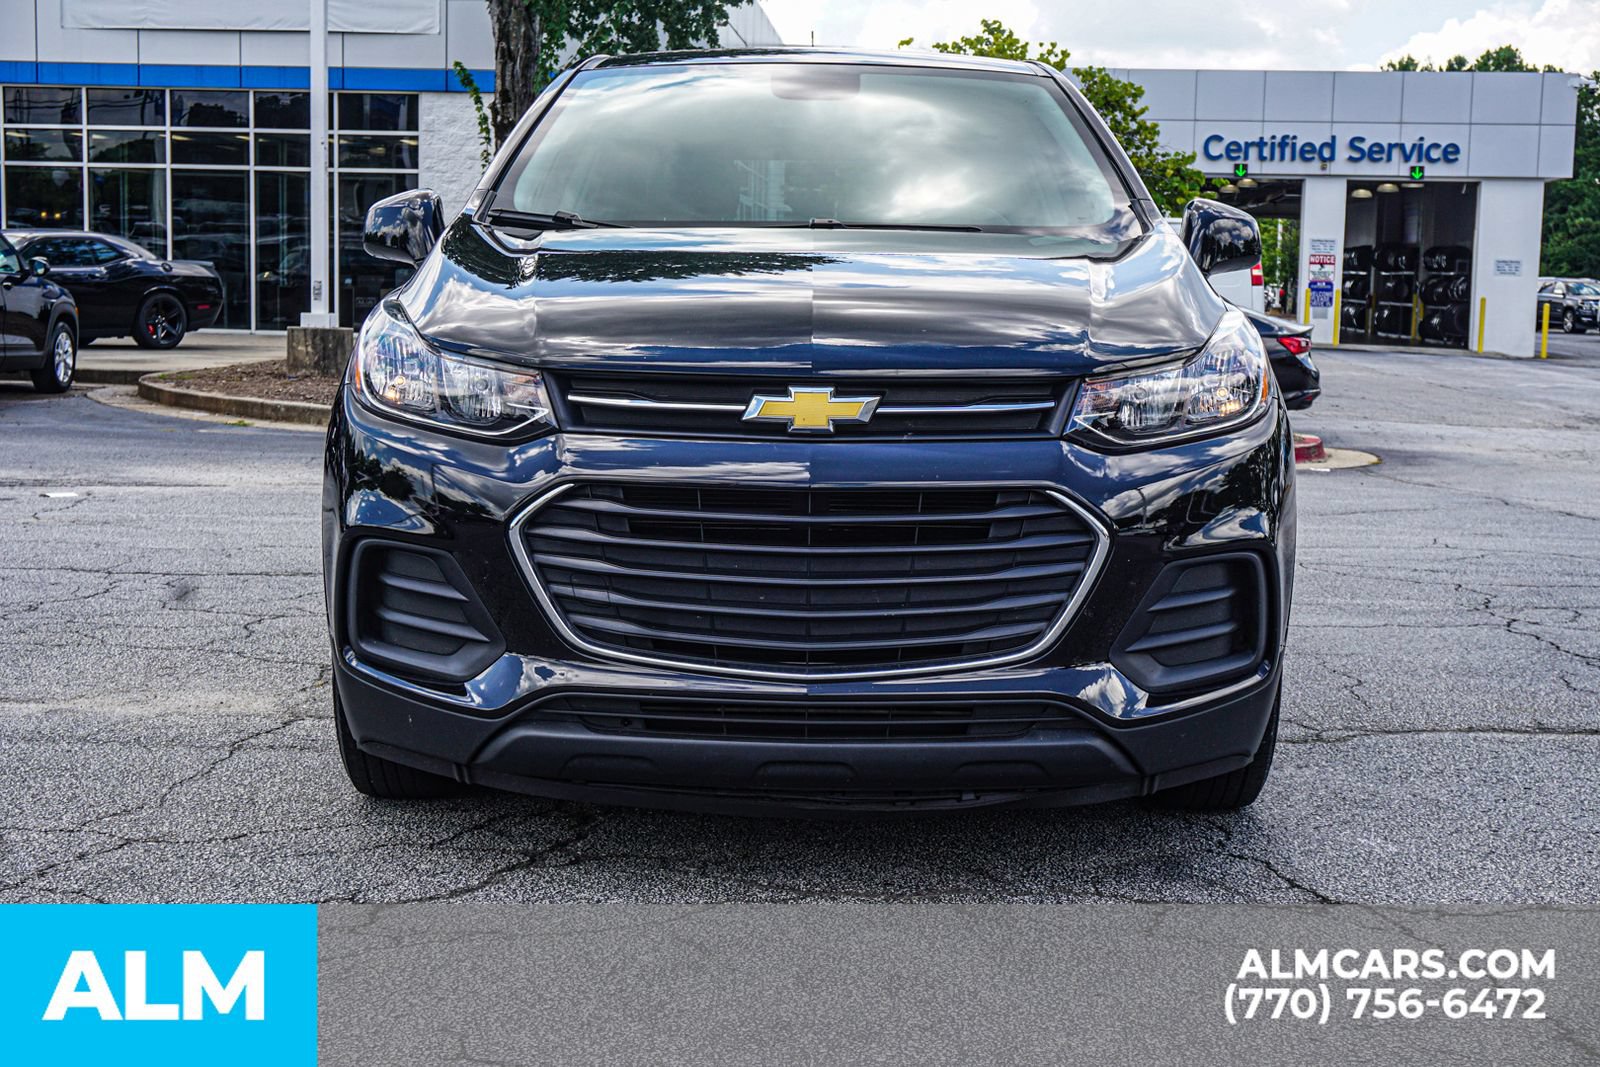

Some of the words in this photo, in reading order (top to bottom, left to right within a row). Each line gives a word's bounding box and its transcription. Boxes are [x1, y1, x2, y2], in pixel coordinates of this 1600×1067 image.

[1203, 134, 1337, 163] Certified
[1346, 137, 1461, 165] Service
[1310, 255, 1335, 264] NOTICE
